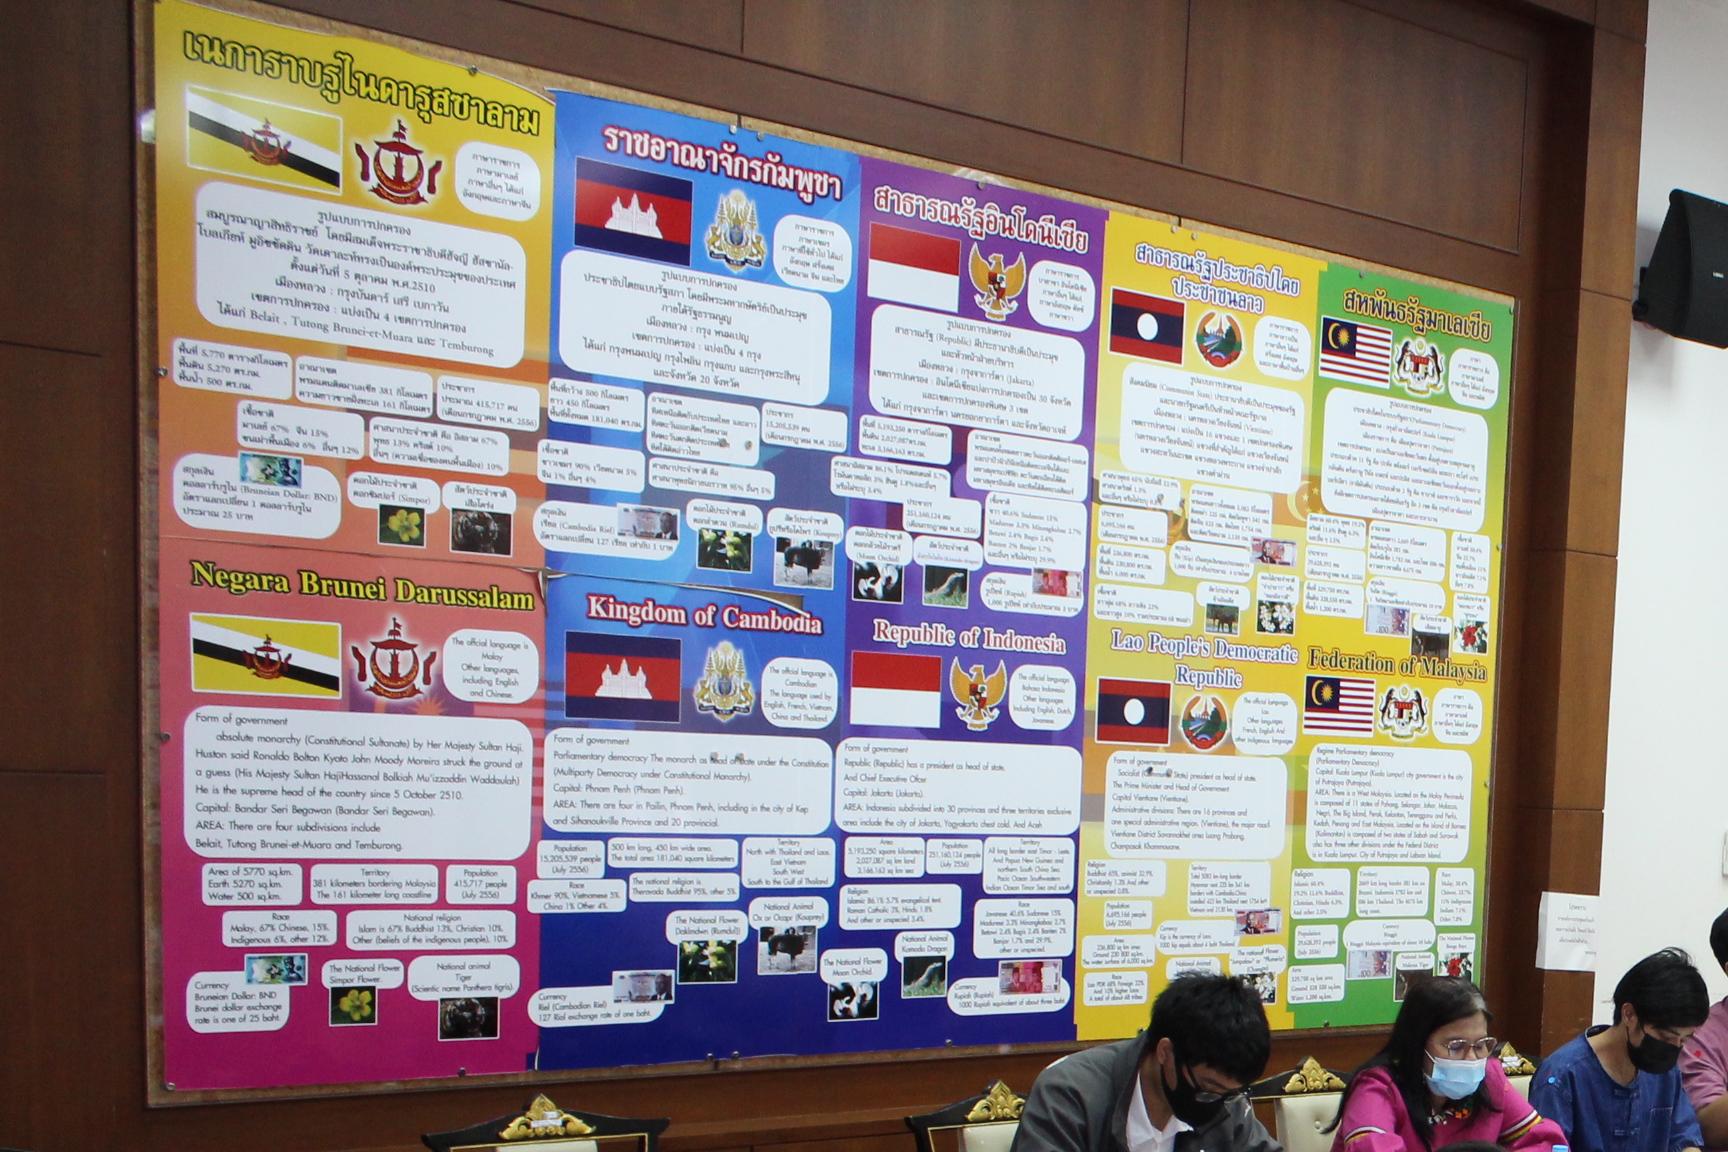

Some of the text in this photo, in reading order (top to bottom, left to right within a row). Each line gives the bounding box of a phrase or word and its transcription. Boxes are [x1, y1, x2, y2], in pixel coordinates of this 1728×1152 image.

[602, 125, 842, 204] ราชอาณาจักรกัมพูชา
[874, 185, 1089, 254] สาธารณรัฐอินโดนีเซีย
[1135, 243, 1300, 296] สาธารณรัฐประชาธิปไตย
[1172, 276, 1264, 314] ประชาชนลาว
[1343, 288, 1492, 343] สหพันธรัฐมาเลเซีย
[192, 561, 534, 611] Negara Brunei Darussalam
[588, 594, 823, 635] Kingdom of Cambodia
[873, 618, 1066, 654] Republic of Indonesia
[452, 637, 464, 646] The
[490, 640, 521, 651] language
[524, 642, 528, 650] is
[1111, 629, 1298, 663] Lao People's Democratic
[481, 652, 503, 662] Malay
[461, 663, 481, 671] Other
[1307, 646, 1488, 685] Federation of Malaysia
[462, 676, 519, 688] including English
[1175, 664, 1242, 690] Republic
[470, 688, 484, 697] and
[196, 712, 288, 726] Form of government
[216, 731, 526, 754] absolute monarchy (Constitutional Sultanate) by Her Majesty Sultan Haji.
[195, 784, 465, 800] He is the supreme head of the country since 5 October 2510.
[235, 803, 268, 814] Bandar
[271, 804, 288, 814] Seri
[292, 805, 332, 817] Begawan
[335, 805, 369, 816] (Bandar
[373, 806, 389, 815] Seri
[392, 807, 436, 818] Begawan).
[195, 820, 225, 830] AREA:
[229, 820, 254, 831] There
[275, 821, 293, 831] four
[297, 822, 348, 832] subdivisions
[351, 822, 381, 832] include
[227, 838, 257, 851] Tutong
[260, 839, 332, 849] Brunei-et-Muara
[335, 839, 352, 850] and
[355, 840, 404, 852] Temburong.
[208, 868, 229, 876] Area
[232, 866, 240, 876] of
[243, 867, 265, 876] 5770
[208, 879, 230, 888] Earth
[233, 879, 255, 888] 5270
[208, 892, 234, 900] Water
[237, 892, 254, 900] 500
[437, 962, 491, 970] National animal
[455, 973, 472, 983] Tiger
[195, 981, 229, 990] Currency
[195, 993, 229, 1001] Bruneian
[259, 991, 277, 999] BND
[222, 1003, 244, 1012] dollar
[246, 1002, 282, 1012] exchange
